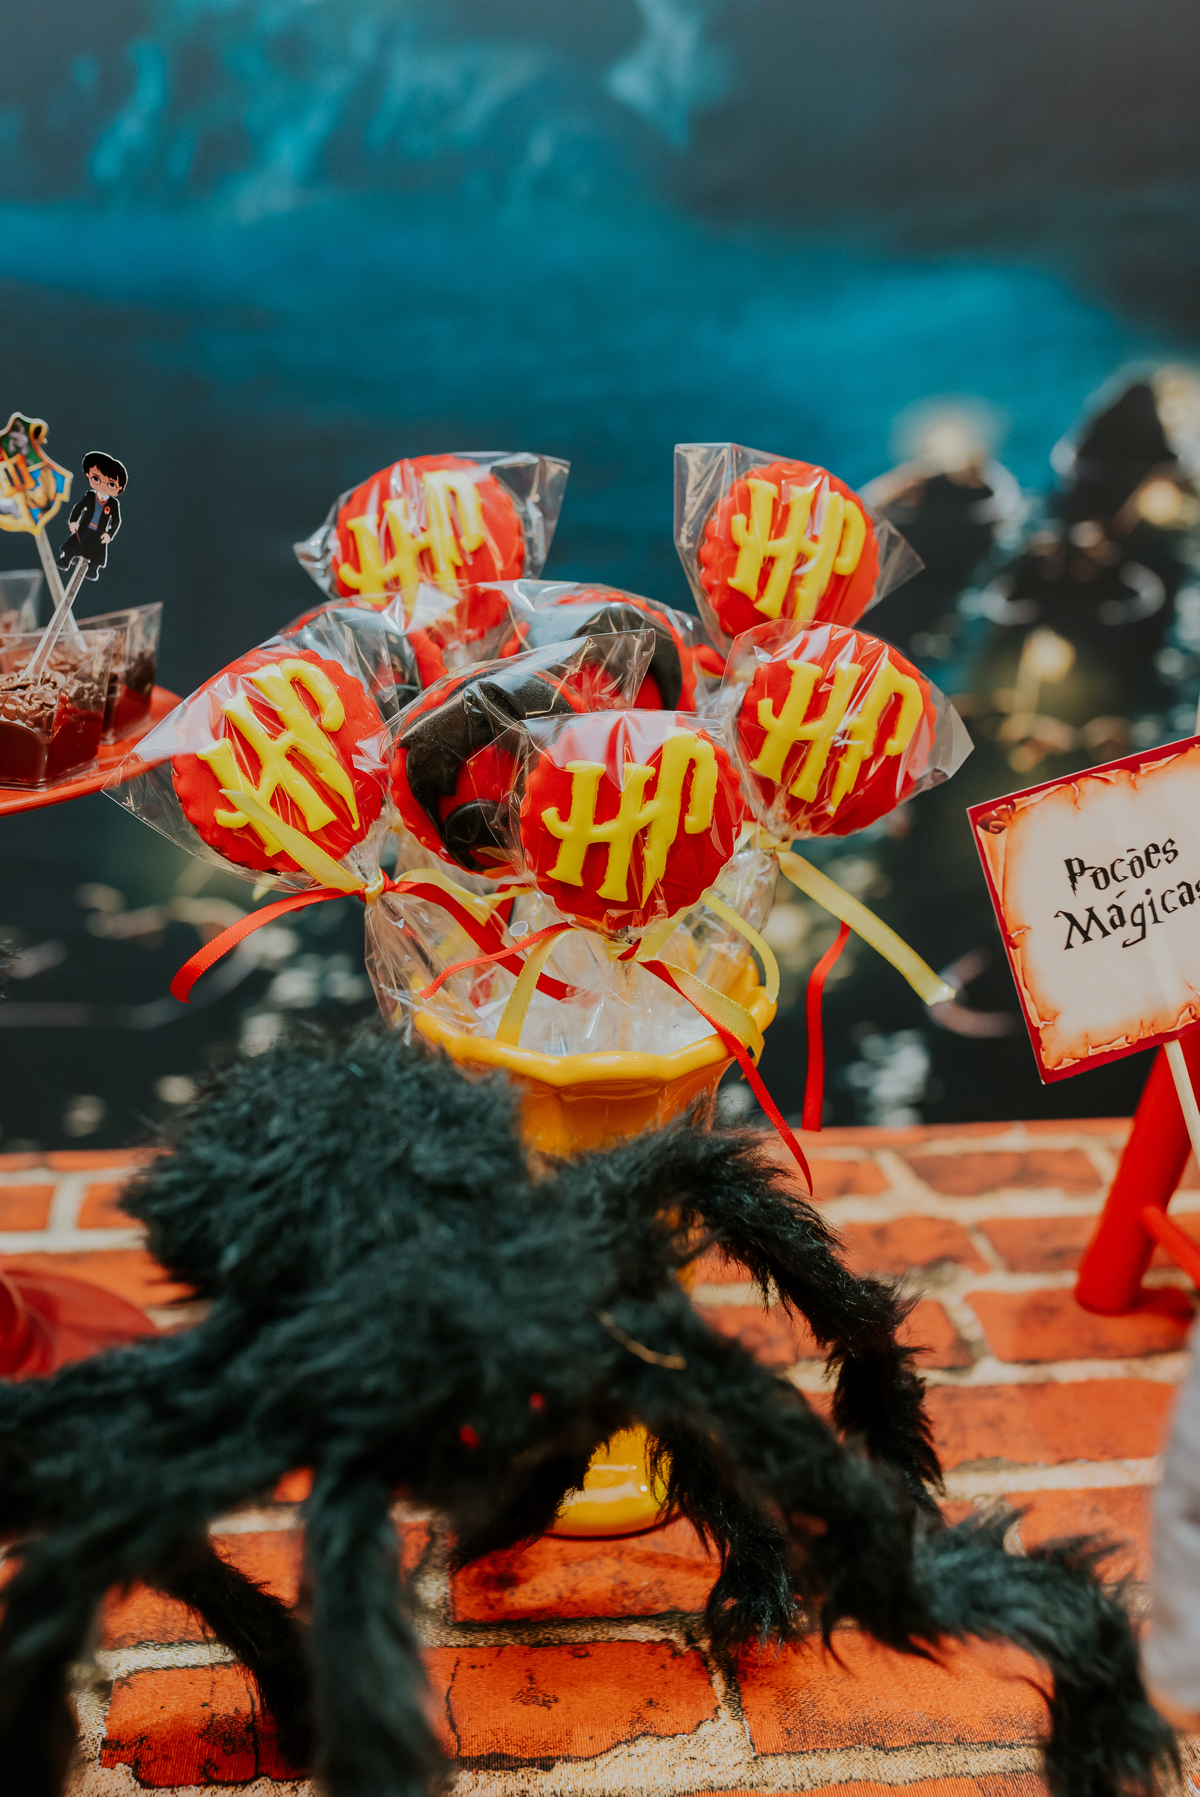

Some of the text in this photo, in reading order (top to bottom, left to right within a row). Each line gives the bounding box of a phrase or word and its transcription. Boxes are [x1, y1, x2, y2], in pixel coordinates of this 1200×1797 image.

[727, 478, 867, 636] HP
[196, 658, 360, 857] HP
[541, 726, 719, 909] HP
[749, 659, 923, 818] HP
